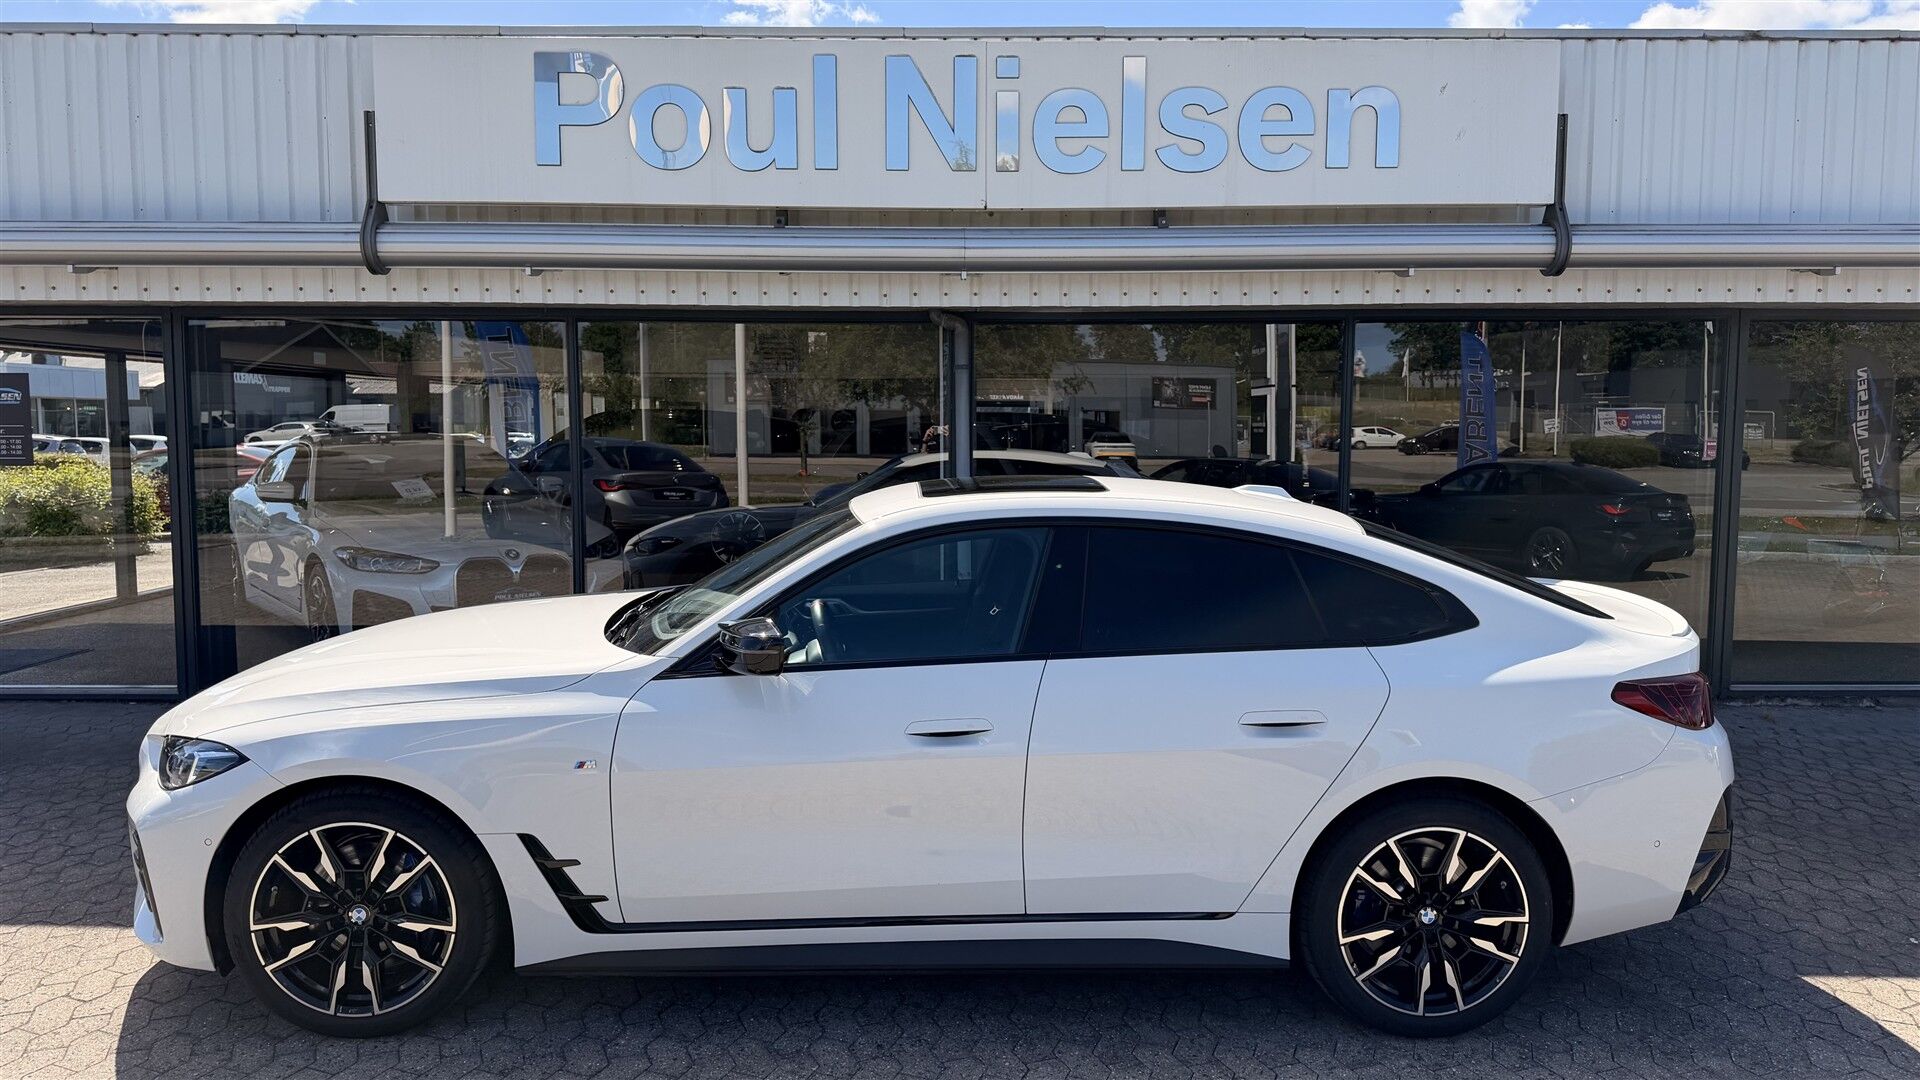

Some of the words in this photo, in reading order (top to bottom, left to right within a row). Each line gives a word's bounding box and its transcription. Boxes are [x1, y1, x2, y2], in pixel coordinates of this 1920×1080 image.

[533, 51, 839, 173] Poul
[884, 53, 1401, 174] Nielsen
[0, 392, 22, 401] SEN
